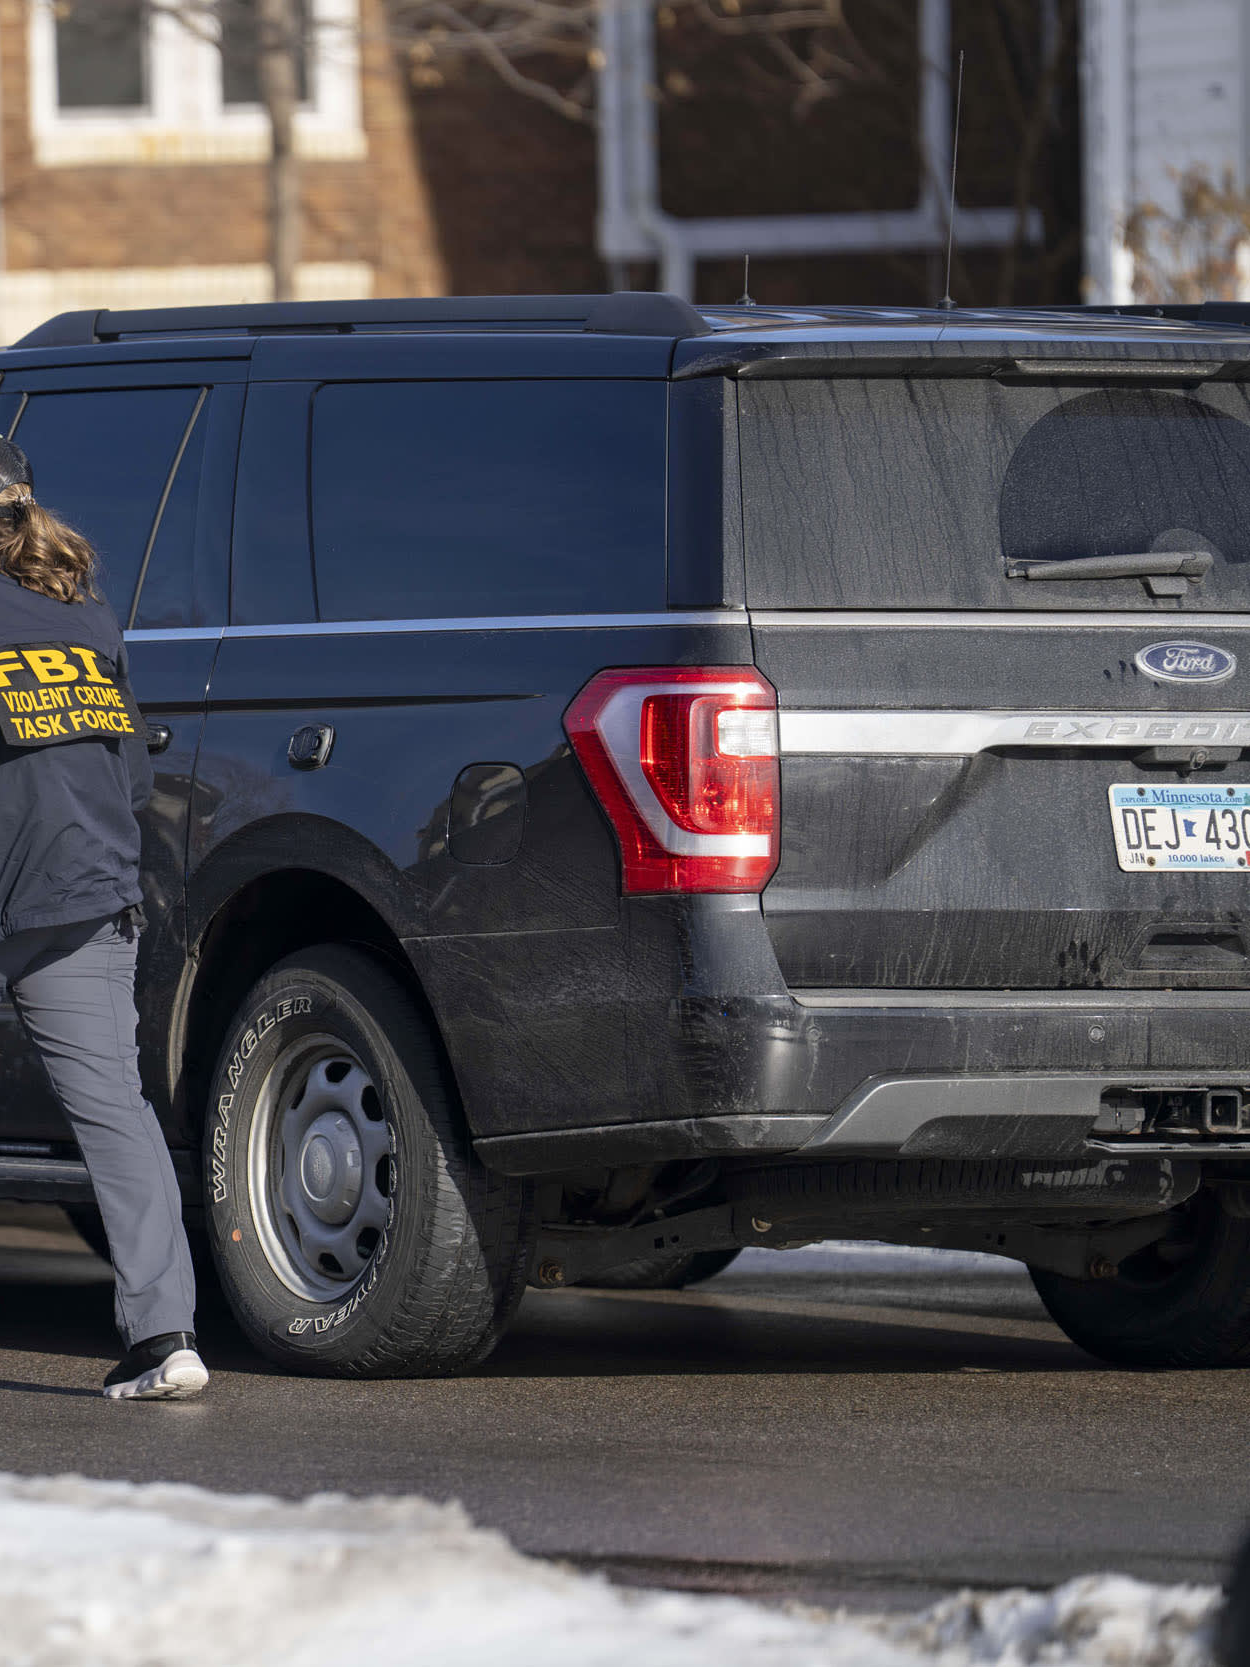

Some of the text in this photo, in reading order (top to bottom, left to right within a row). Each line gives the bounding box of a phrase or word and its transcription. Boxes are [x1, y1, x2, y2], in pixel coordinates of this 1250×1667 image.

[1163, 647, 1216, 672] Ford
[1, 686, 125, 713] VIOLENT CRIME
[10, 708, 135, 739] TASK FORCE
[1023, 721, 1250, 739] EXPEDI
[1122, 808, 1180, 850] DEJ
[1130, 852, 1146, 864] JAN
[1168, 854, 1225, 863] 10,000 lakes
[213, 997, 312, 1203] WRANGLER
